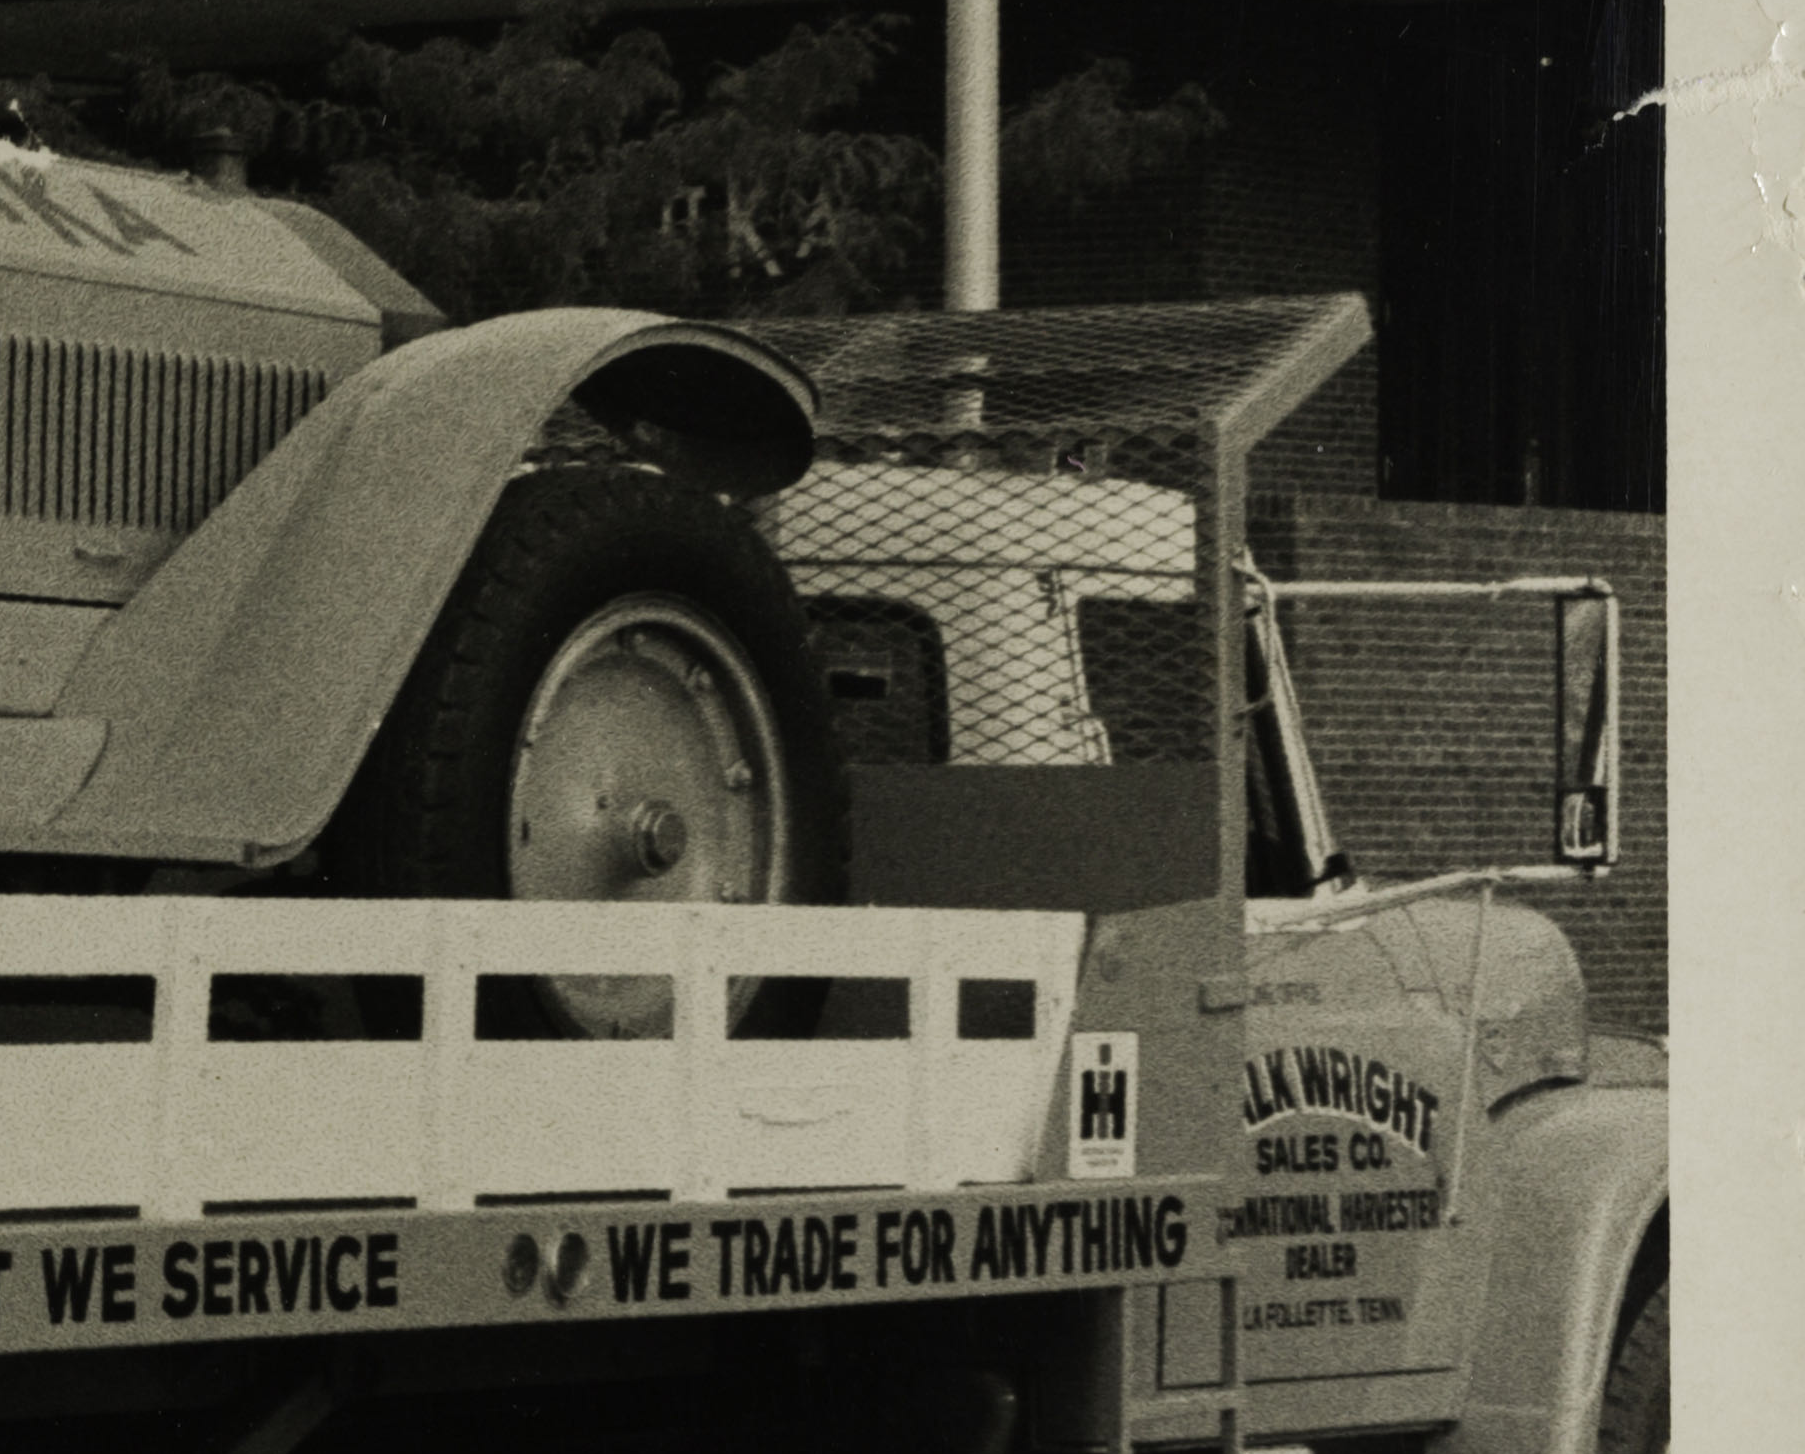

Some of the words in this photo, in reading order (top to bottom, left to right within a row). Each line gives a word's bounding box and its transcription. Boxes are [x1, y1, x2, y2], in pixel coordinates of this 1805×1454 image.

[1243, 1047, 1297, 1126] LK
[1292, 1046, 1439, 1153] WRIGHT
[1256, 1134, 1339, 1175] SALES
[1348, 1132, 1393, 1172] CO.
[1339, 1189, 1440, 1233] HARVESTER
[40, 1244, 137, 1326] WE
[160, 1233, 399, 1319] SERVICE
[606, 1222, 691, 1303] WE
[710, 1214, 858, 1297] TRADE
[875, 1208, 957, 1289] FOR
[969, 1195, 1187, 1281] ANYTHING
[1285, 1241, 1358, 1279] DEALER
